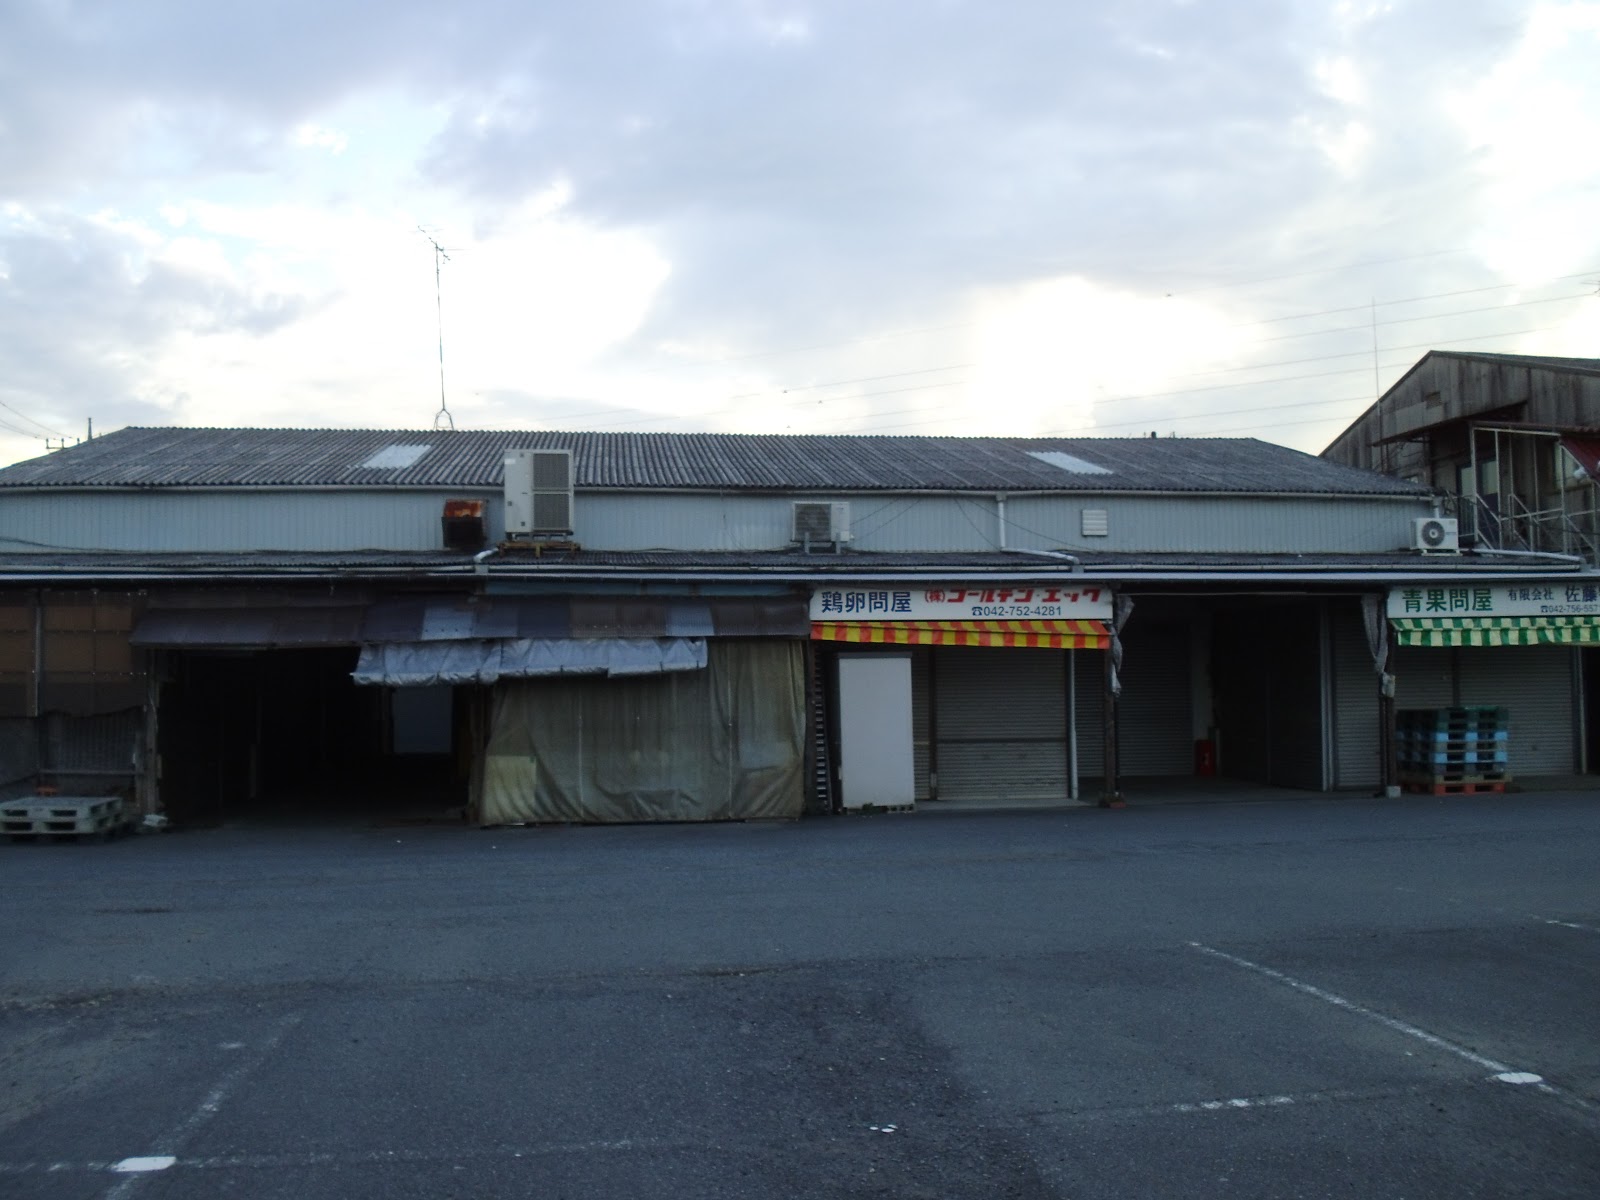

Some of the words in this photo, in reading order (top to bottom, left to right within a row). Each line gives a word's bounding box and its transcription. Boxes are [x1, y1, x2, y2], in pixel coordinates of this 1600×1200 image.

[821, 591, 912, 613] 鶏卵問屋
[1402, 589, 1493, 612] 青果問屋
[1507, 587, 1554, 601] 有限会社
[1565, 585, 1600, 602] 佐藤
[984, 606, 1061, 616] 042-752-4281
[1549, 604, 1600, 613] 042-756-557
